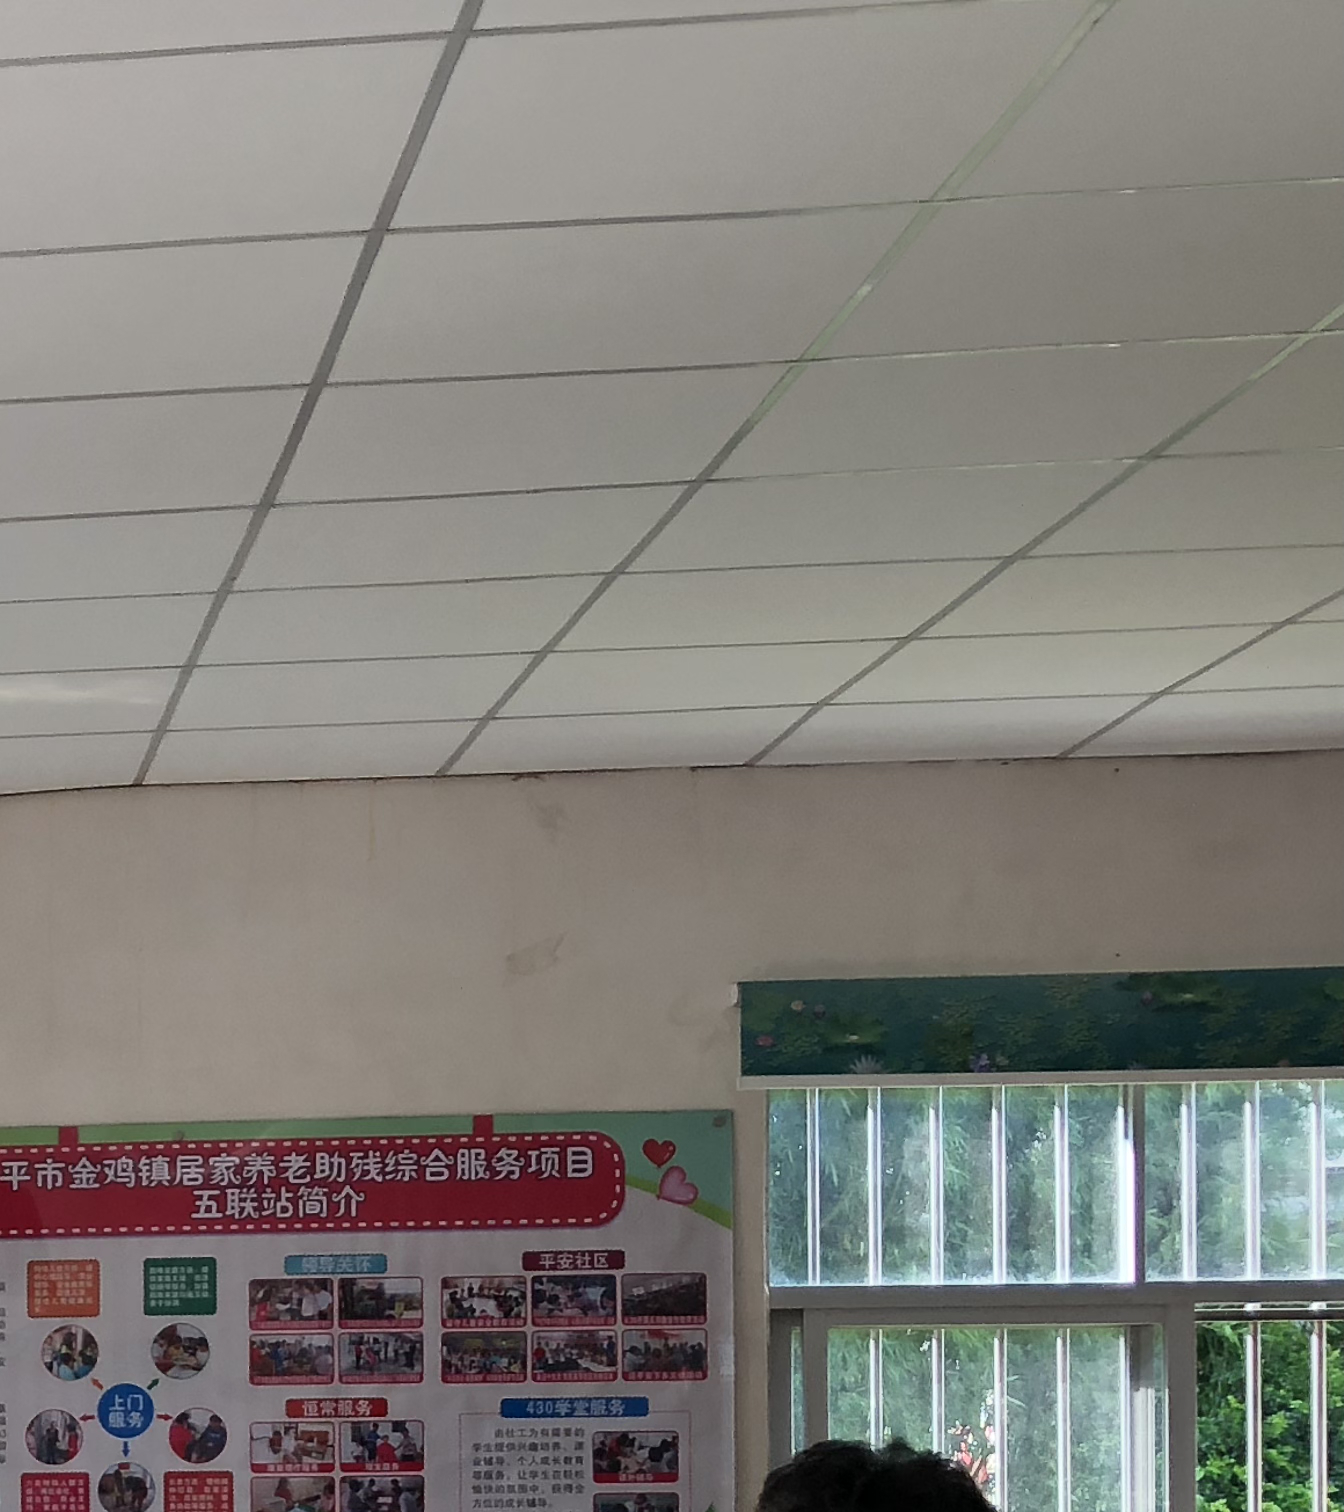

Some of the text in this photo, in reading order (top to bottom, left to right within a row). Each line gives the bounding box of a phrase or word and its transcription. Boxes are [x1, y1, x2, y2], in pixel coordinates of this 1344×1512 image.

[191, 1186, 365, 1219] 五联站简介
[539, 1252, 609, 1269] 平安社区
[109, 1394, 144, 1411] 上门
[302, 1401, 373, 1416] 恒常服务
[526, 1399, 626, 1416] 430学堂服务
[109, 1412, 144, 1428] 服务
